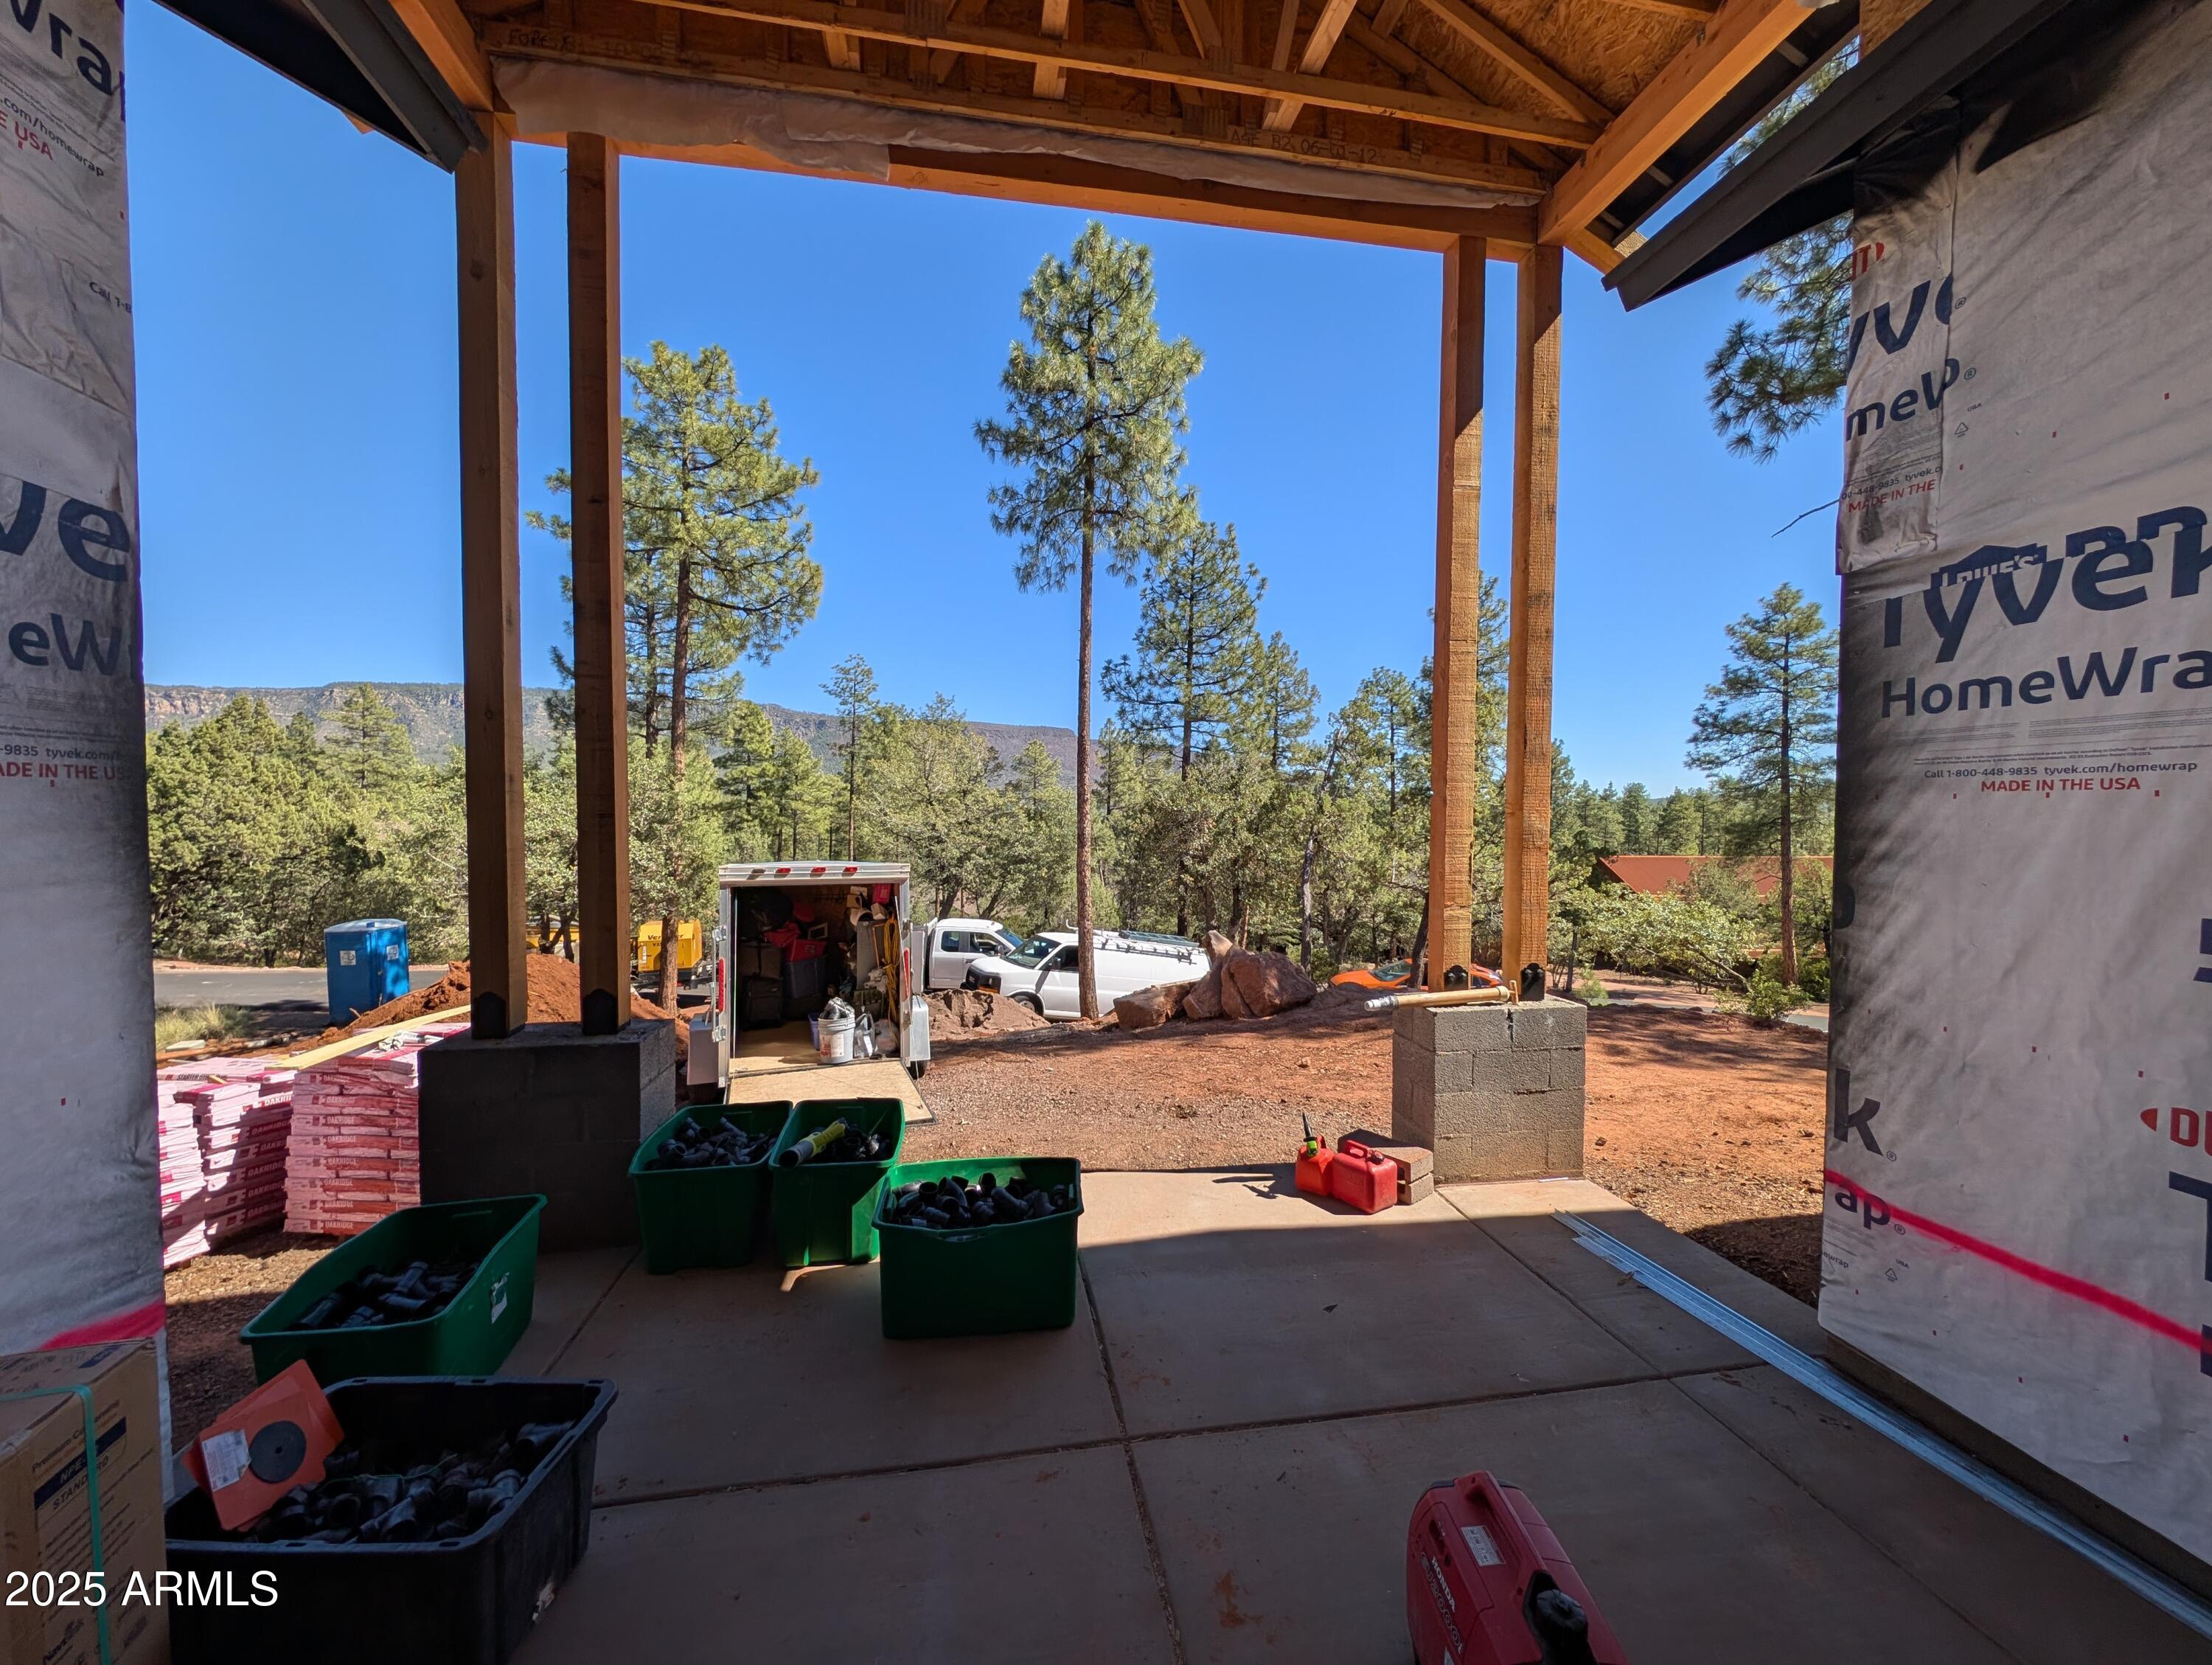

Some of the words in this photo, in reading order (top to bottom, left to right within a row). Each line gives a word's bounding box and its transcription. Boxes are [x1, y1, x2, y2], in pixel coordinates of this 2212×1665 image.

[15, 121, 53, 161] USA
[89, 282, 111, 303] Call
[1848, 493, 1888, 512] MADE
[1891, 488, 1905, 501] IN
[1908, 479, 1936, 496] THE
[39, 763, 58, 778] IN
[63, 764, 99, 779] THE
[1924, 770, 1944, 779] Call
[1947, 766, 2038, 778] 1-800-448-9835
[2044, 762, 2197, 776] tyvek.com/homewrap
[1980, 779, 2031, 792] MADE
[2036, 779, 2055, 791] IN
[2059, 778, 2095, 790] THE
[2100, 777, 2141, 790] USA
[1431, 1555, 1455, 1613] HONDA
